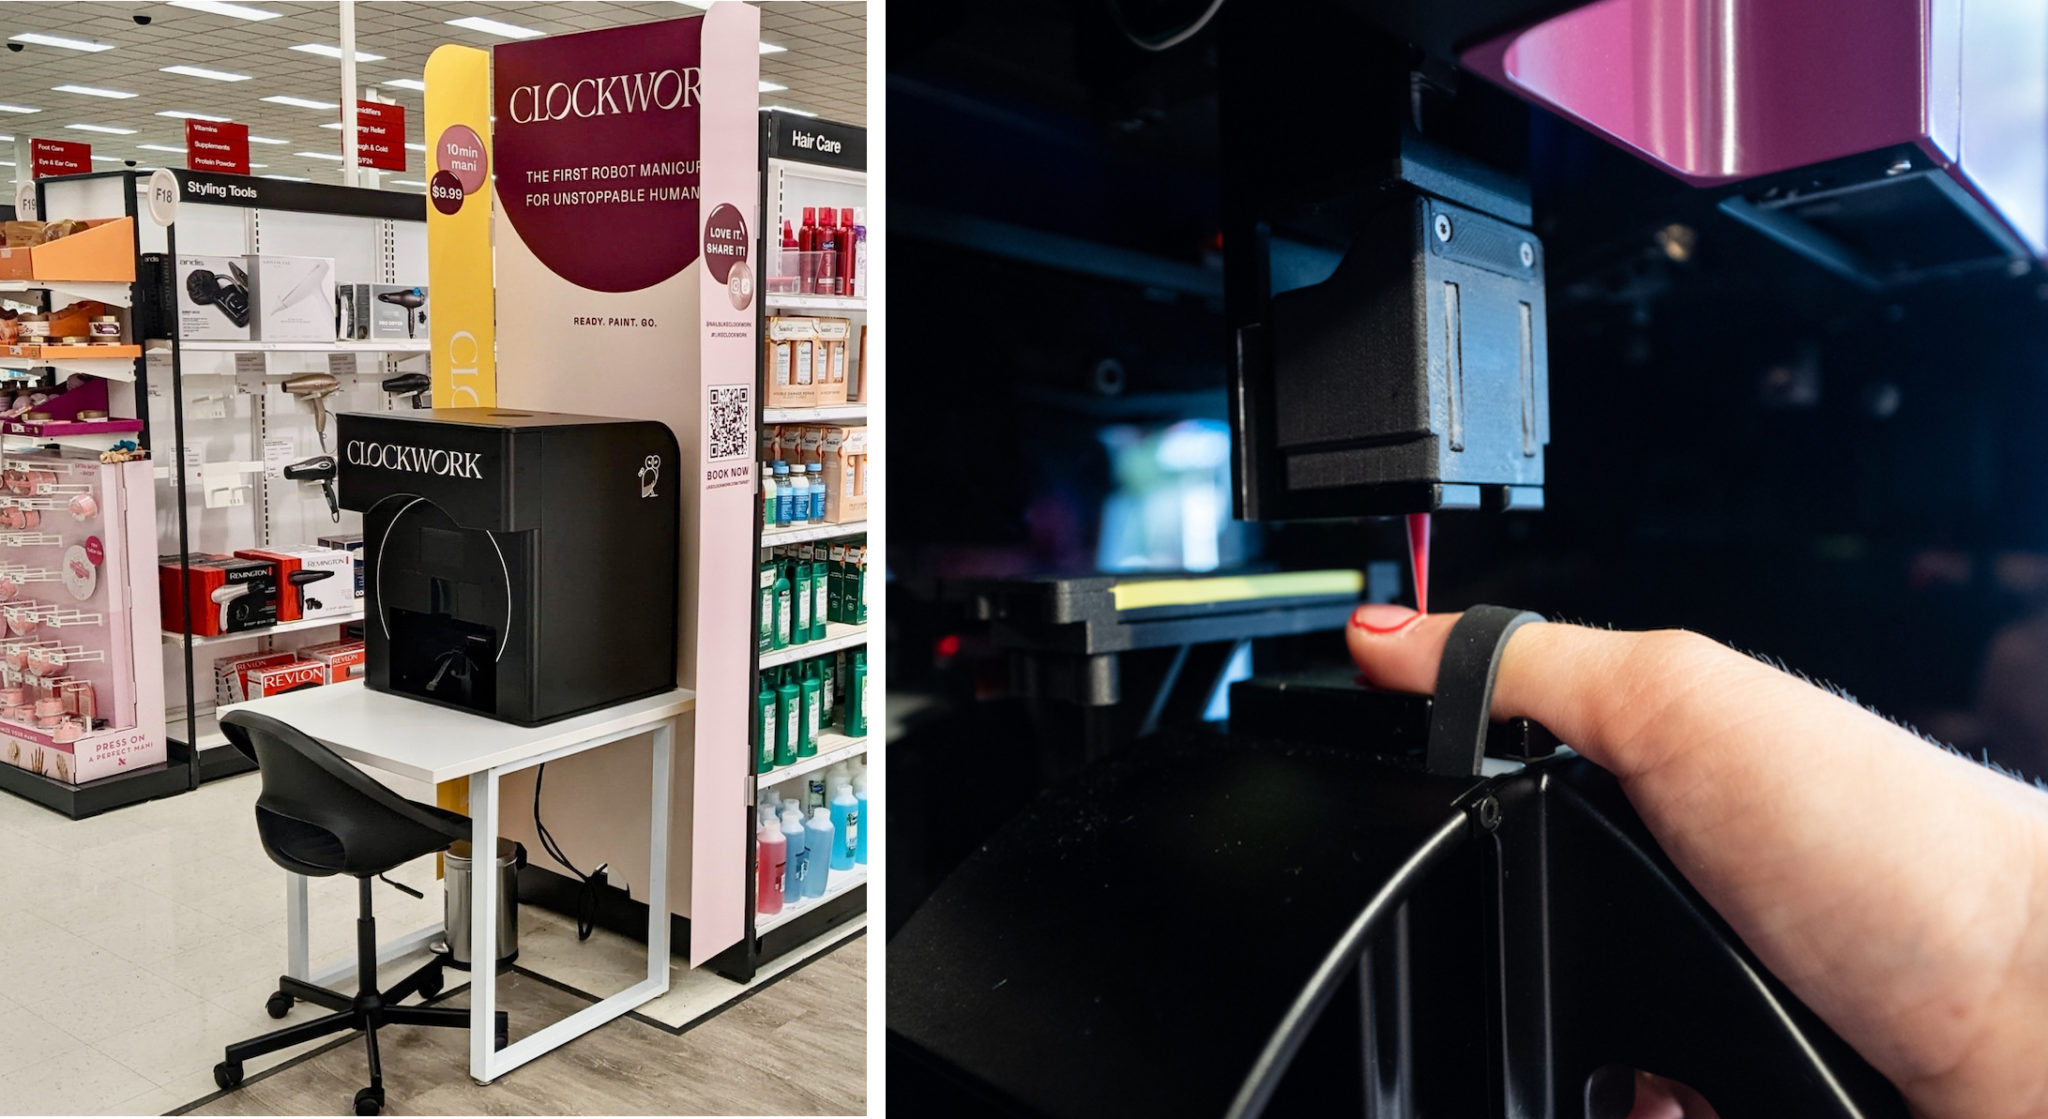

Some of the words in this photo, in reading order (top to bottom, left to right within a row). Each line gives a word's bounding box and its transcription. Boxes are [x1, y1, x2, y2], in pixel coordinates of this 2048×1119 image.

[193, 124, 218, 133] Vitamins
[370, 126, 386, 135] Relief
[194, 141, 230, 151] Supplements
[792, 130, 815, 149] Hair
[816, 135, 841, 154] Care
[375, 145, 388, 153] Cold
[39, 158, 49, 166] Eye
[64, 160, 78, 168] Care
[195, 157, 215, 166] Protein
[215, 160, 236, 168] Powder
[451, 160, 477, 172] mani
[526, 170, 549, 183] THE
[553, 167, 588, 182] FIRST
[591, 165, 636, 180] ROBOT
[156, 188, 173, 203] F18
[187, 181, 226, 198] Styling
[228, 184, 257, 198] Tools
[432, 185, 462, 200] $9.99
[526, 193, 550, 206] FOR
[554, 188, 645, 206] UNSTOPPABLE
[710, 227, 732, 239] LOVE
[733, 229, 743, 240] IT.
[706, 243, 734, 256] SHARE
[735, 246, 746, 257] IT!
[179, 259, 204, 267] andis
[573, 317, 605, 326] READY.
[608, 317, 638, 327] PAINT.
[641, 318, 657, 327] GO.
[347, 440, 484, 480] CLOCKWORK
[707, 469, 729, 481] BOOK
[731, 466, 749, 478] NOW
[307, 559, 344, 567] REMINGTON
[230, 569, 268, 580] REMINGTON
[237, 659, 267, 671] REVLON
[332, 654, 358, 665] REVLON
[264, 667, 323, 689] REVLON
[96, 740, 127, 752] PRESS
[130, 735, 145, 745] ON
[96, 748, 131, 761] PERFECT
[134, 742, 153, 751] MANI
